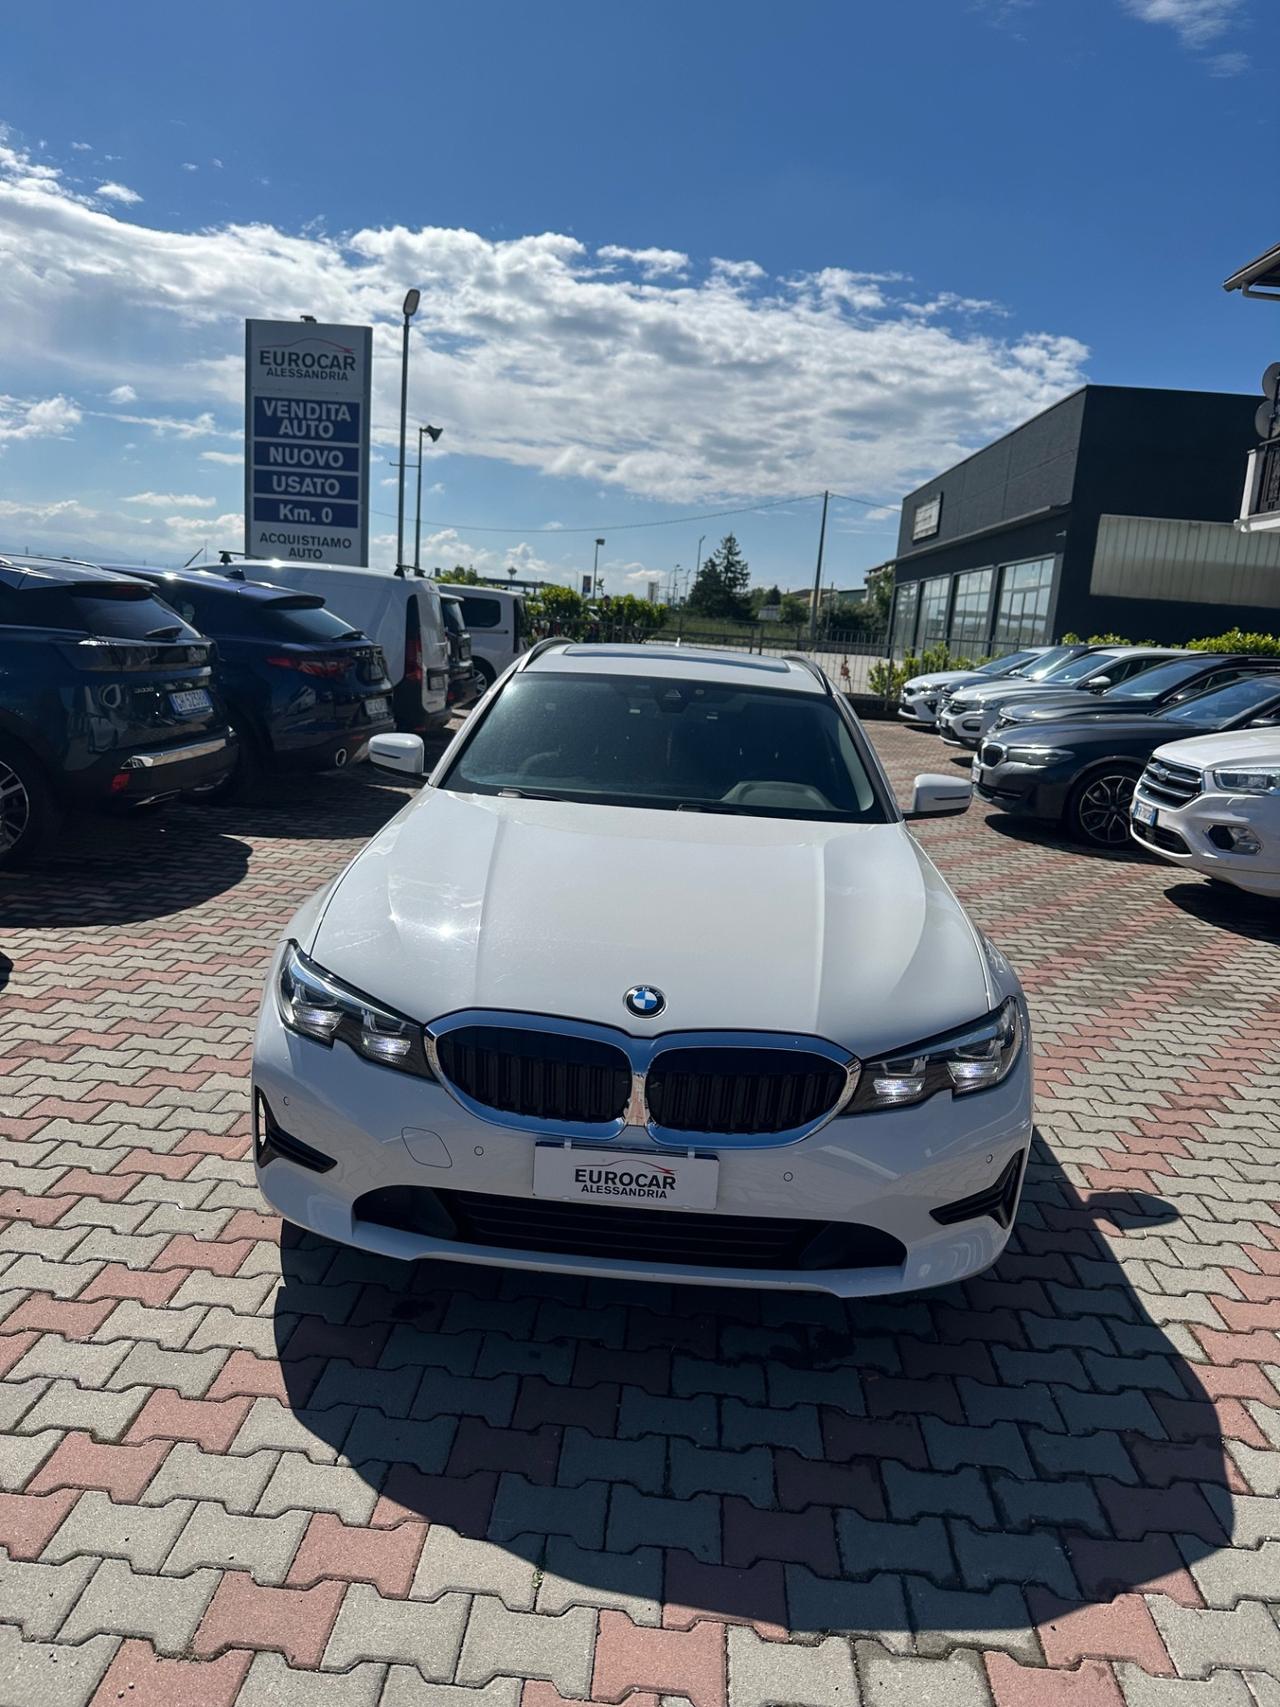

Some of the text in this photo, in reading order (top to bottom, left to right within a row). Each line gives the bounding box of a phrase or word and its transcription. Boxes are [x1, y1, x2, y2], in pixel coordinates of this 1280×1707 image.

[259, 350, 356, 371] EUROCAR
[266, 367, 349, 381] ALESSANDRIA
[262, 400, 351, 422] VENDITA
[278, 419, 334, 439] AUTO
[269, 447, 344, 468] NUOVO
[272, 475, 340, 496] USATO
[279, 504, 333, 523] Km. 0
[259, 532, 352, 549] ACQUISTIAMO
[288, 547, 323, 560] AUTO
[574, 1168, 676, 1191] EUROCAR
[581, 1184, 667, 1199] ALESSANDRIA
